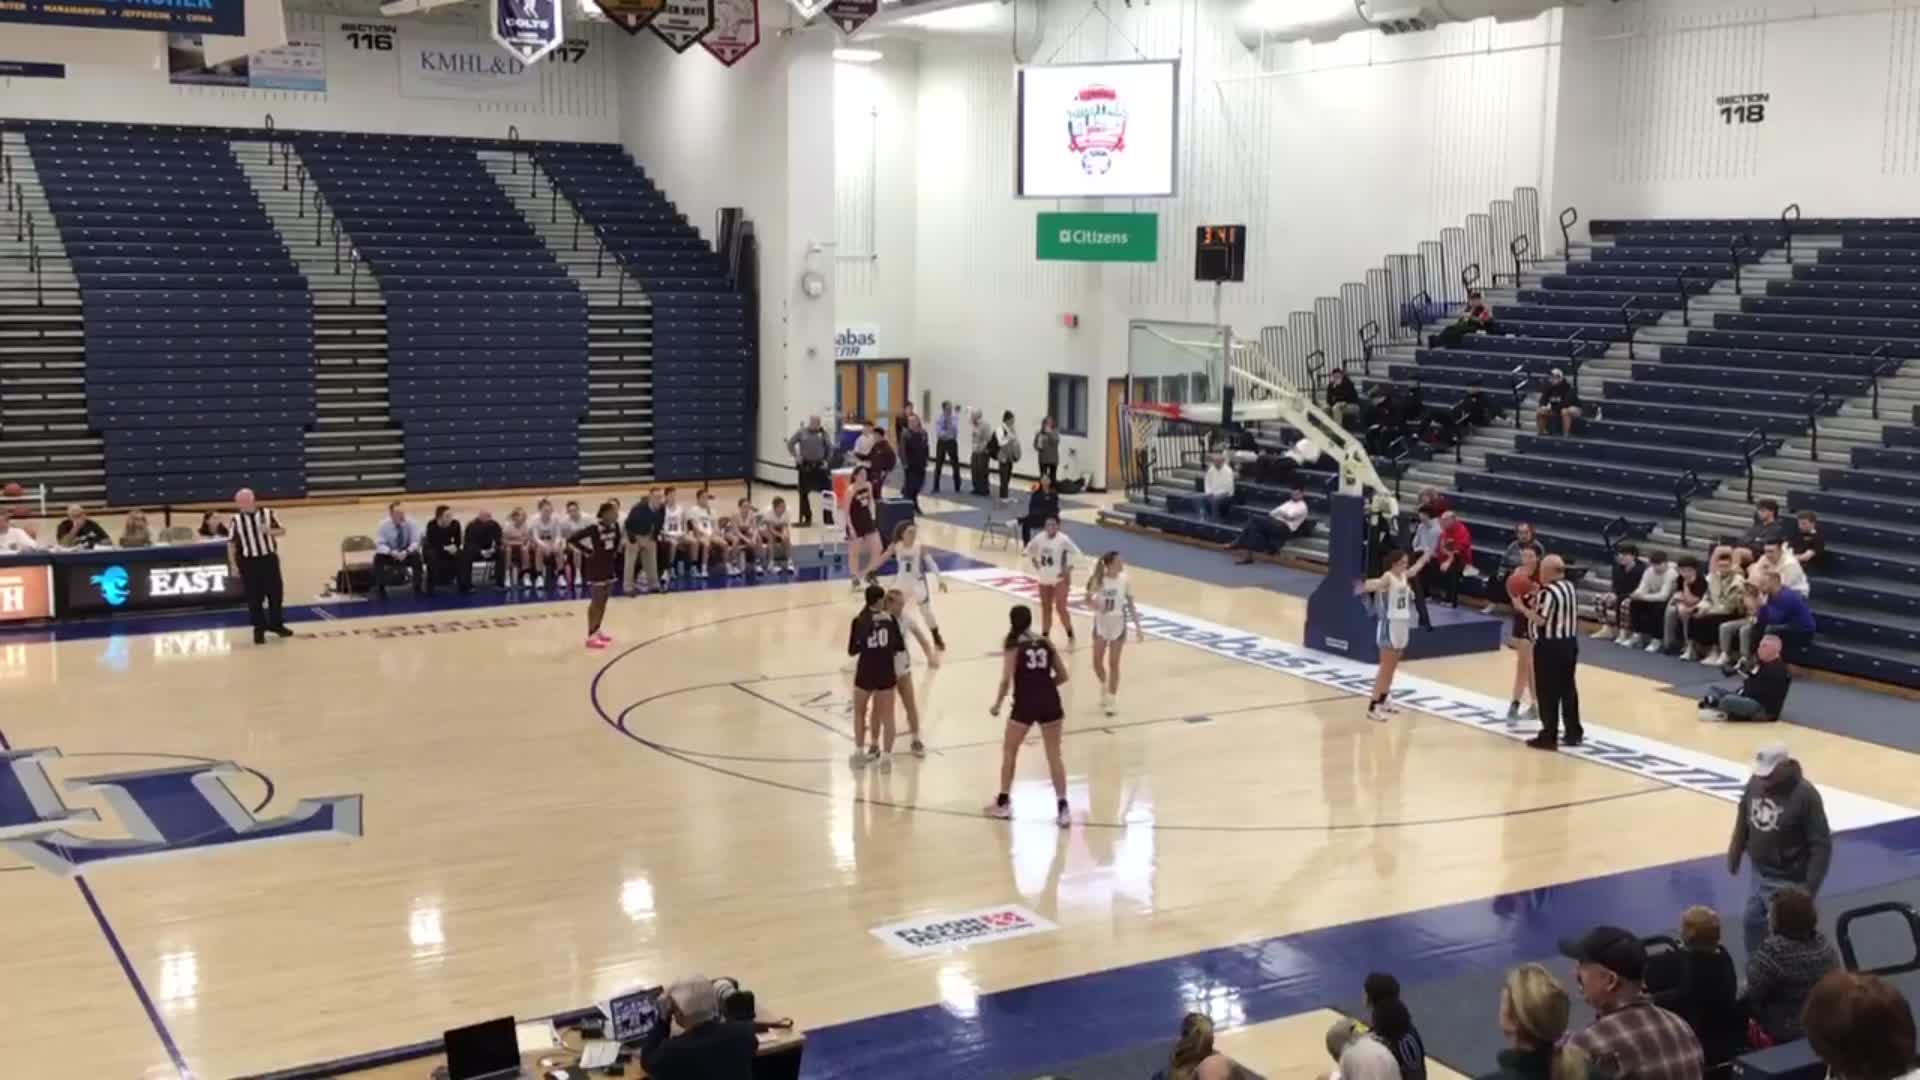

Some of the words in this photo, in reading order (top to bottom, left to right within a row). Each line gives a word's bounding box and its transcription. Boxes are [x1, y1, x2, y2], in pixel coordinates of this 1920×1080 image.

[505, 17, 550, 30] COLTS
[346, 33, 393, 51] 116
[420, 50, 525, 76] KMHL&D
[549, 47, 587, 63] 117
[1715, 93, 1770, 106] SECTION
[1720, 104, 1765, 124] 118
[1073, 229, 1129, 245] Citizens
[834, 327, 876, 346] abas
[149, 570, 227, 597] EAST
[867, 628, 889, 649] 20
[1025, 648, 1048, 669] 33
